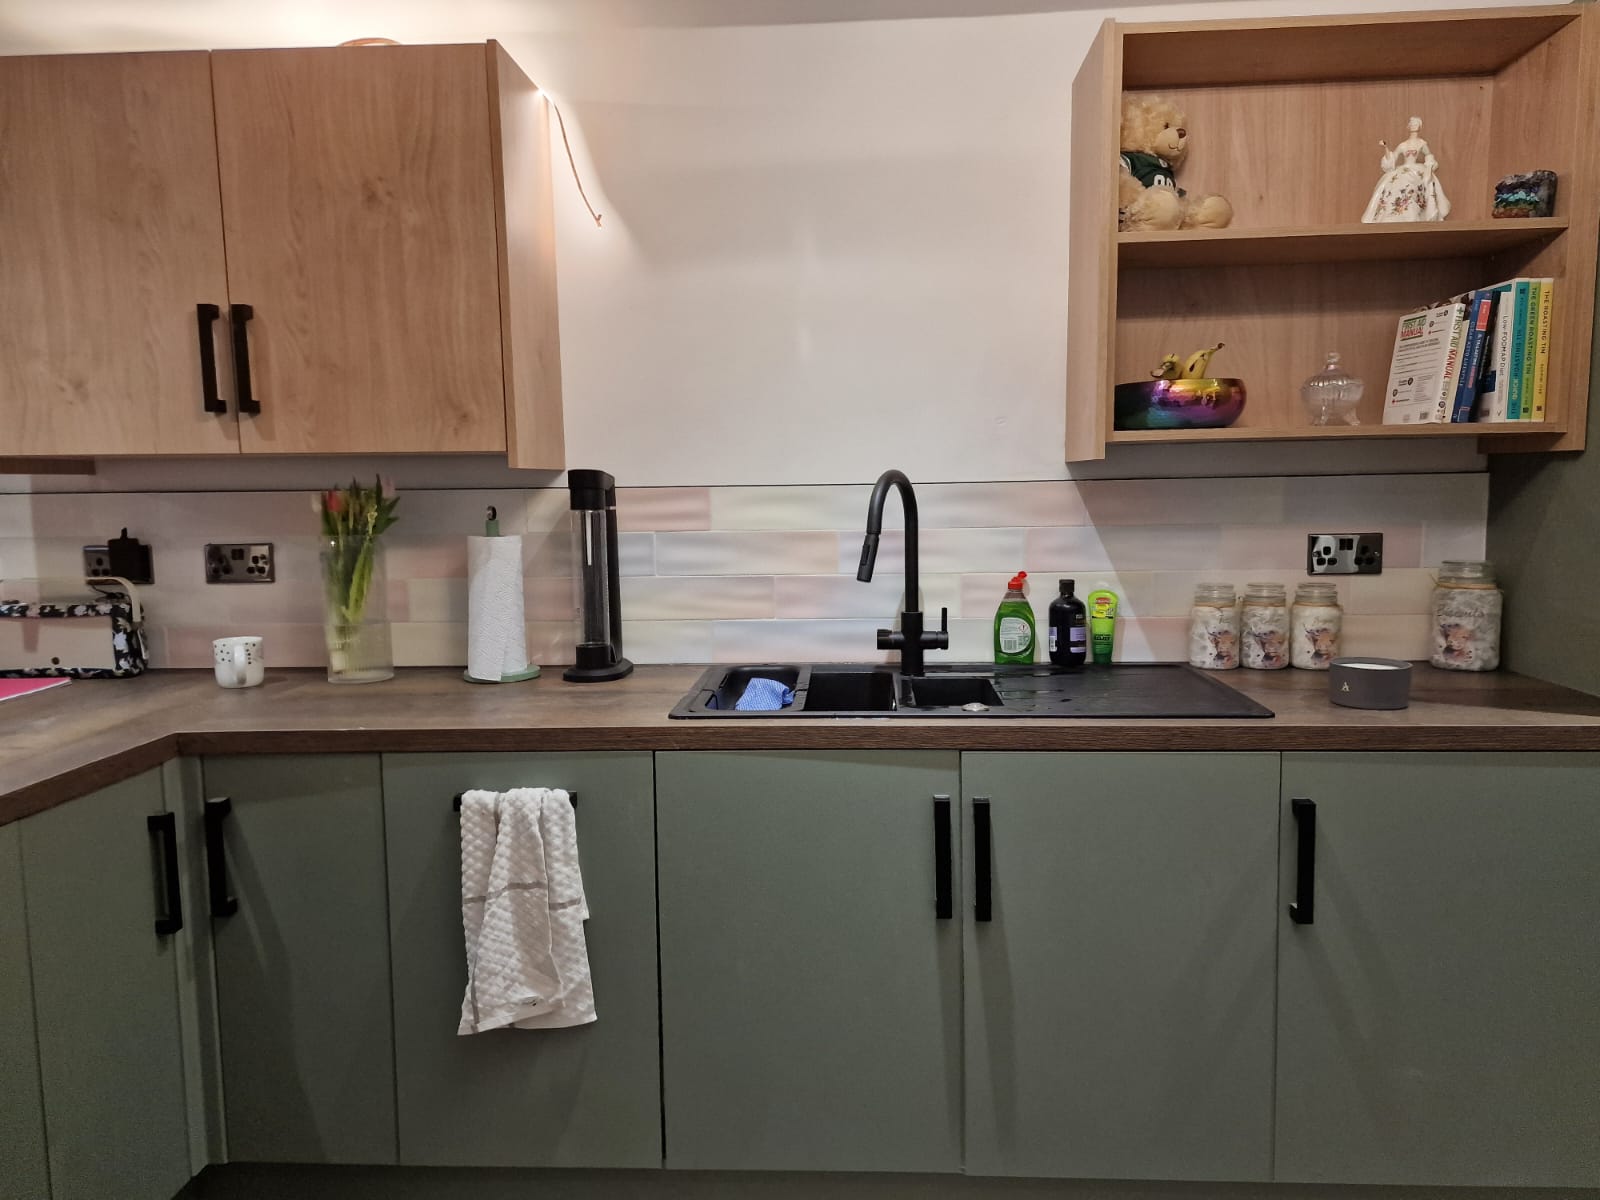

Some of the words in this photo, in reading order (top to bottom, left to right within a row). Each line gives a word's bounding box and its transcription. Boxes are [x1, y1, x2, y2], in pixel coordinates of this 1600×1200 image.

[1401, 326, 1424, 338] MANUAL
[1402, 320, 1417, 329] FIRST
[1417, 317, 1427, 327] AID
[1452, 316, 1463, 335] FIRST
[1541, 305, 1549, 341] ROASTING
[1451, 336, 1459, 348] AID
[1526, 326, 1534, 361] ROASTING
[1443, 348, 1458, 379] MANUAL
